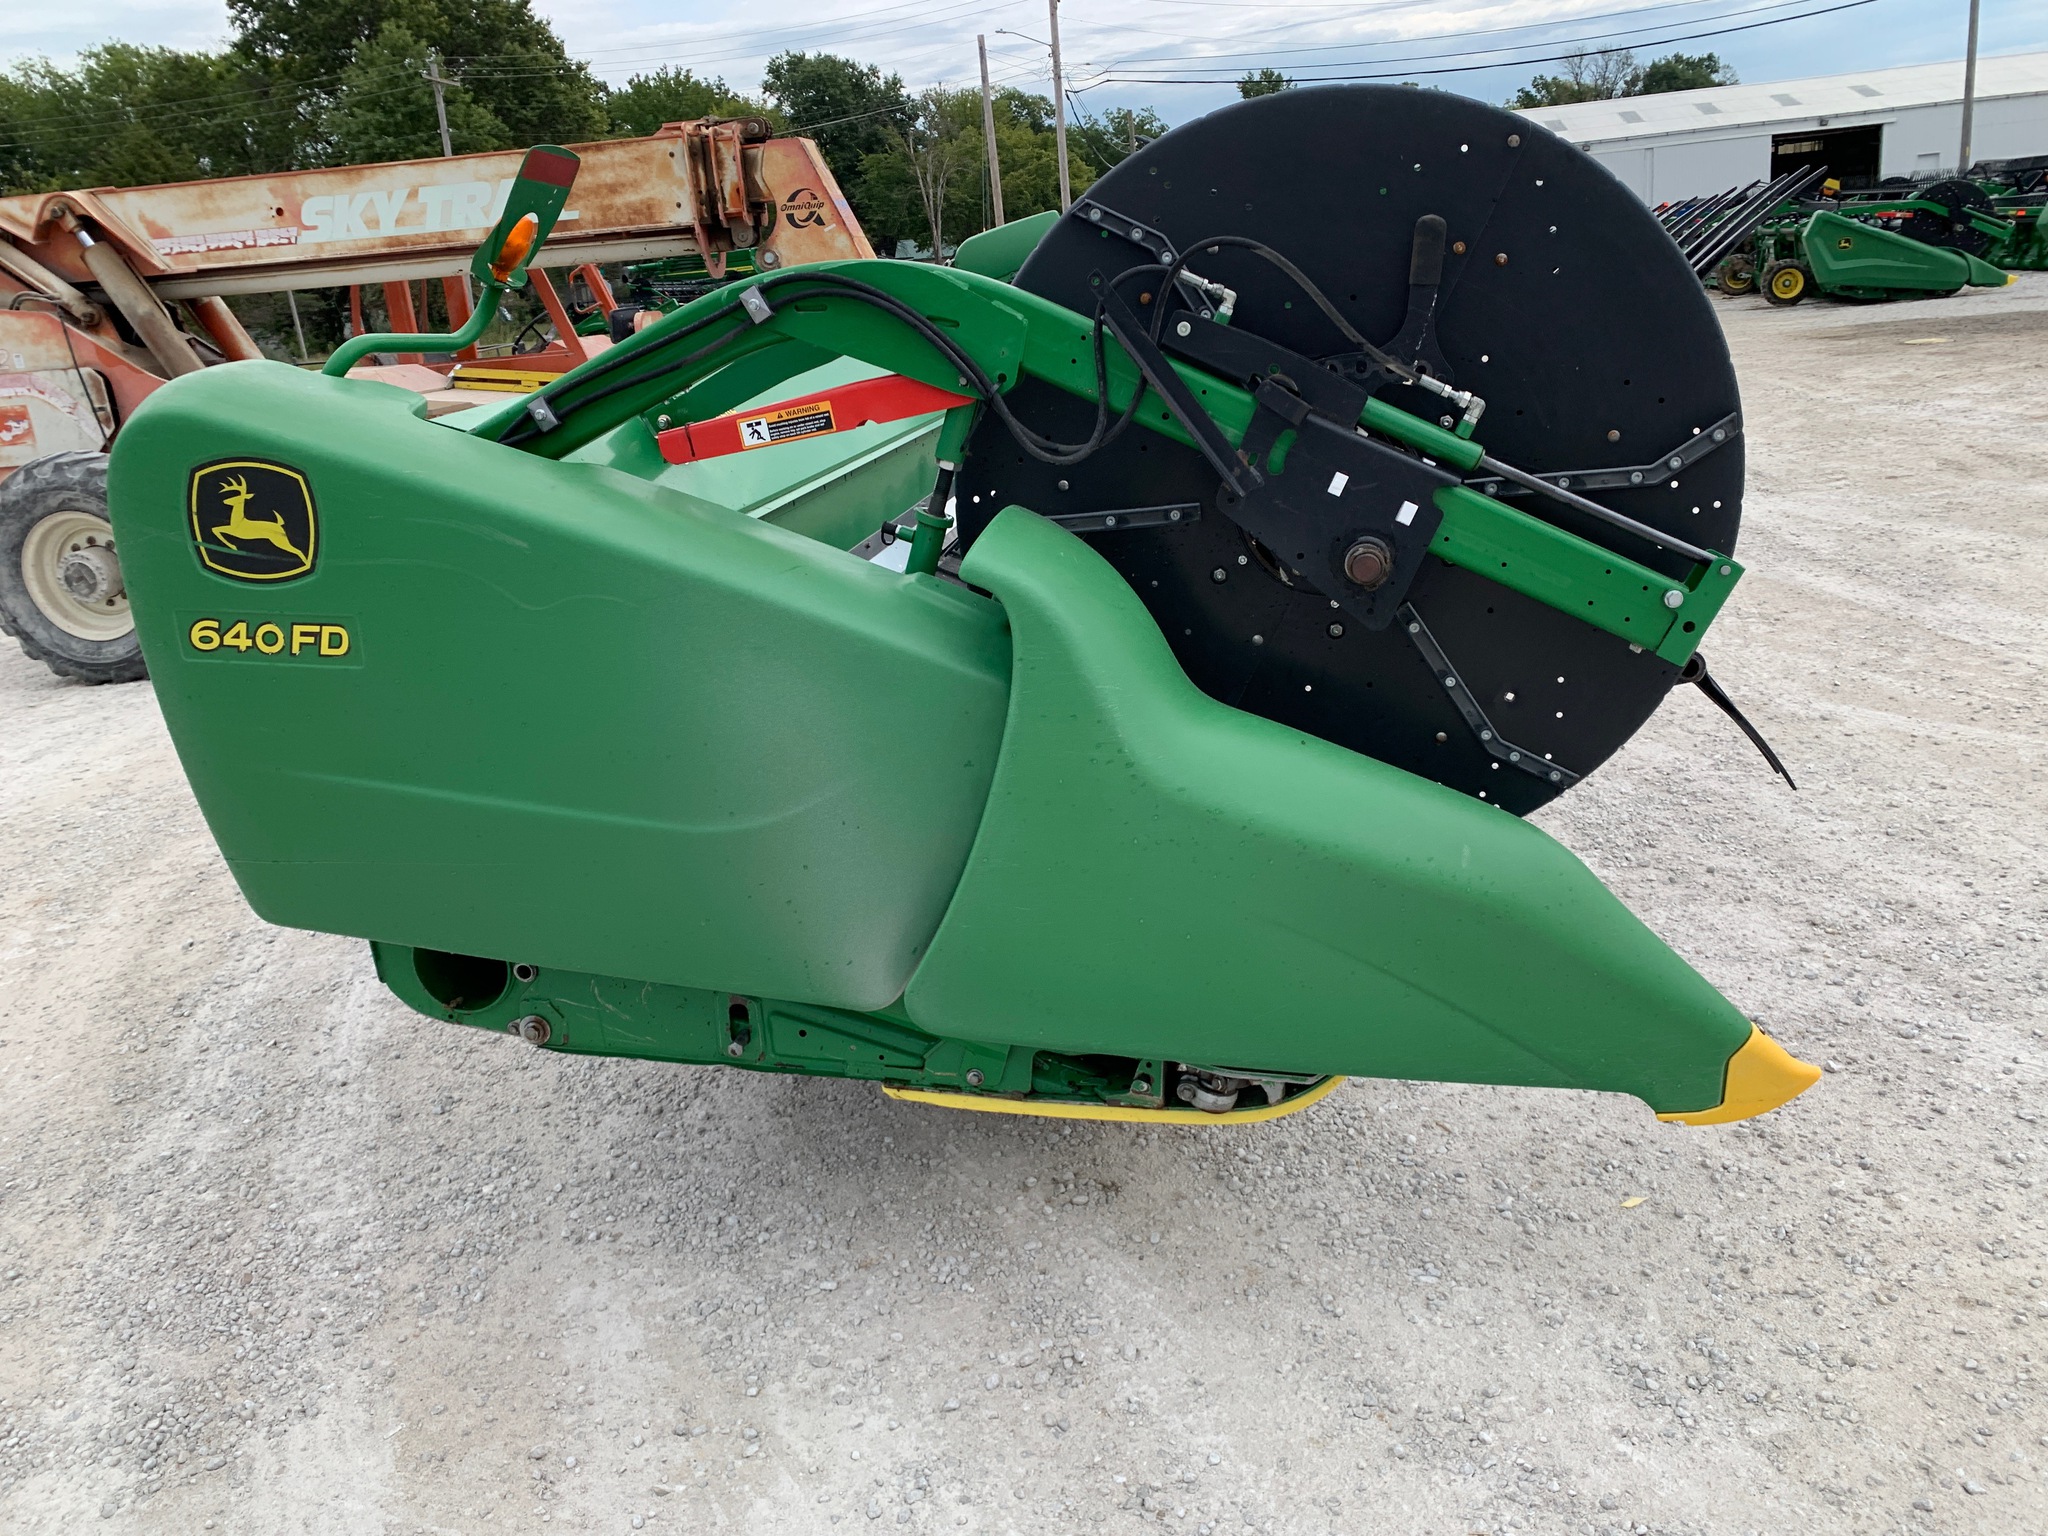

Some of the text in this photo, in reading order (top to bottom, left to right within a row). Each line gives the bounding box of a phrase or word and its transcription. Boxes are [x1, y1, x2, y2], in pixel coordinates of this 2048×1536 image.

[780, 201, 825, 212] OmniQuip
[300, 189, 412, 243] SKY
[785, 405, 820, 417] WARNING
